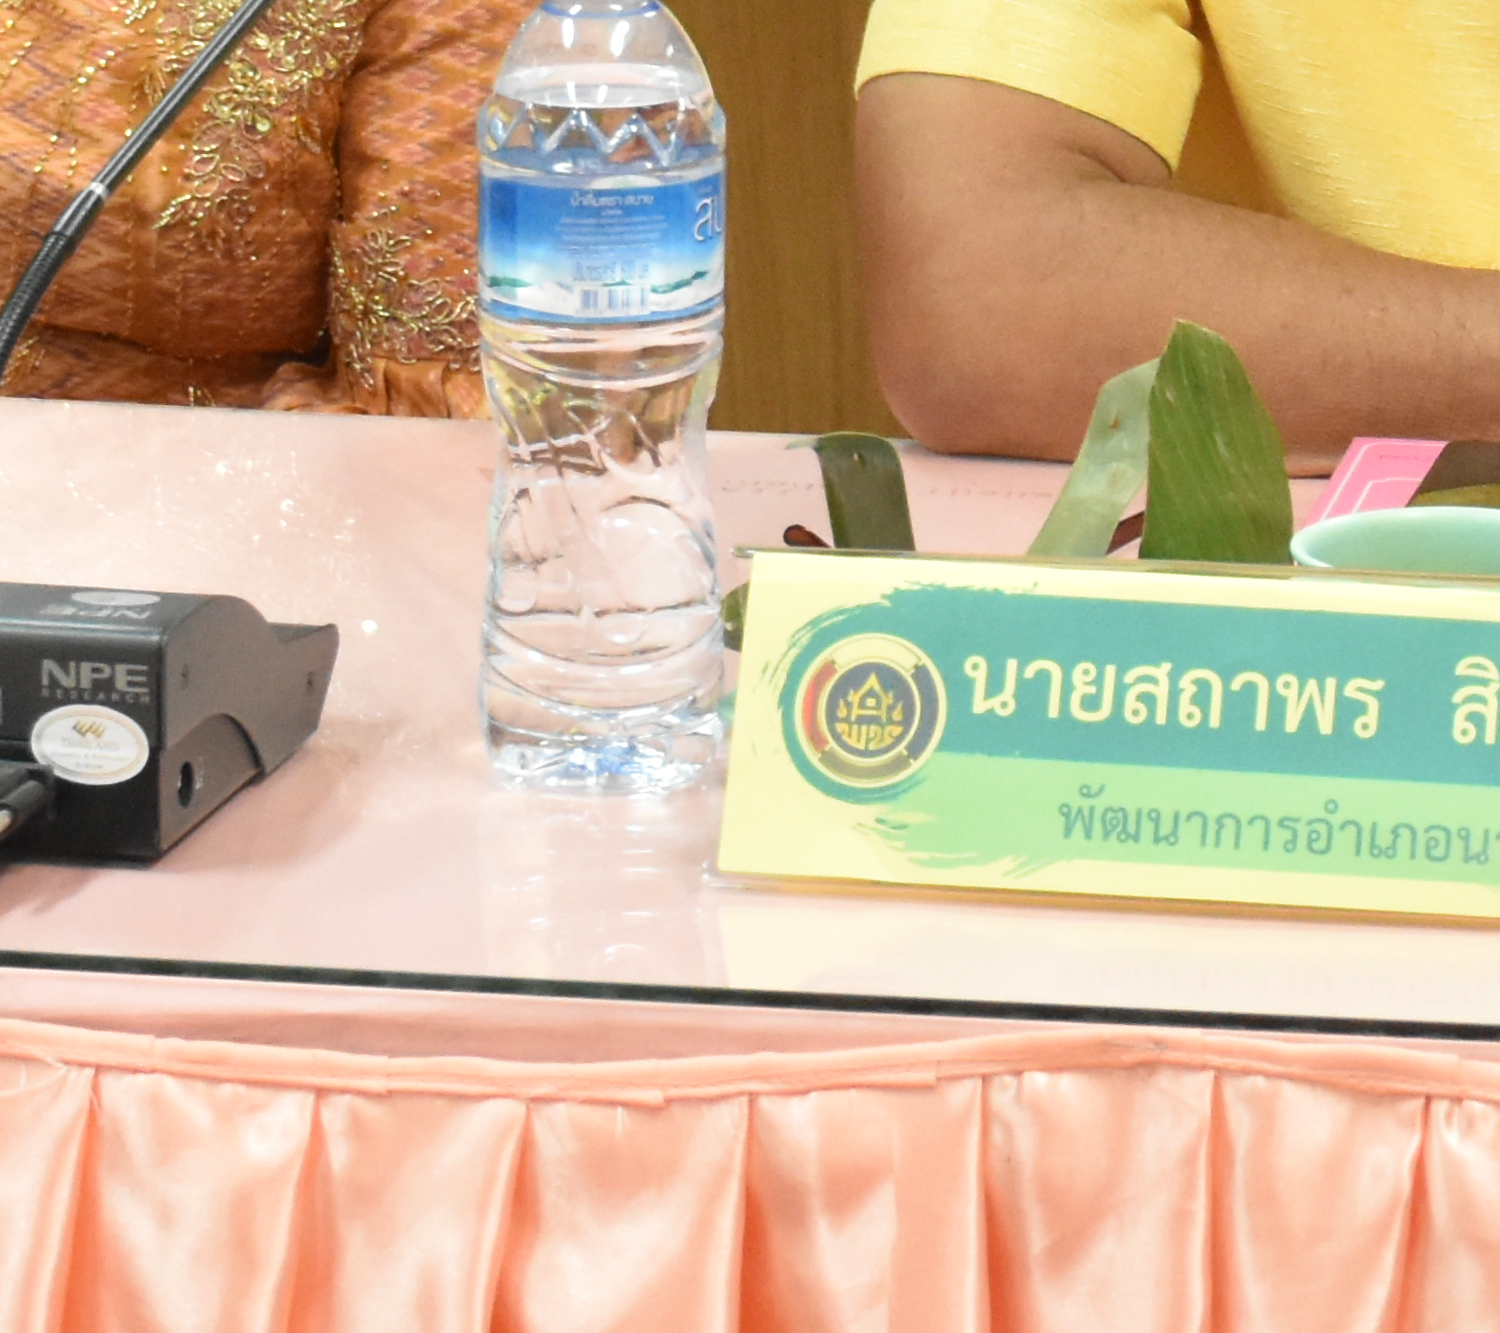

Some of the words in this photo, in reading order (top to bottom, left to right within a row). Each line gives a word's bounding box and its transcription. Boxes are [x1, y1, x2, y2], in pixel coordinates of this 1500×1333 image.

[40, 658, 149, 692] NPE
[962, 654, 1387, 740] นายสถาพร
